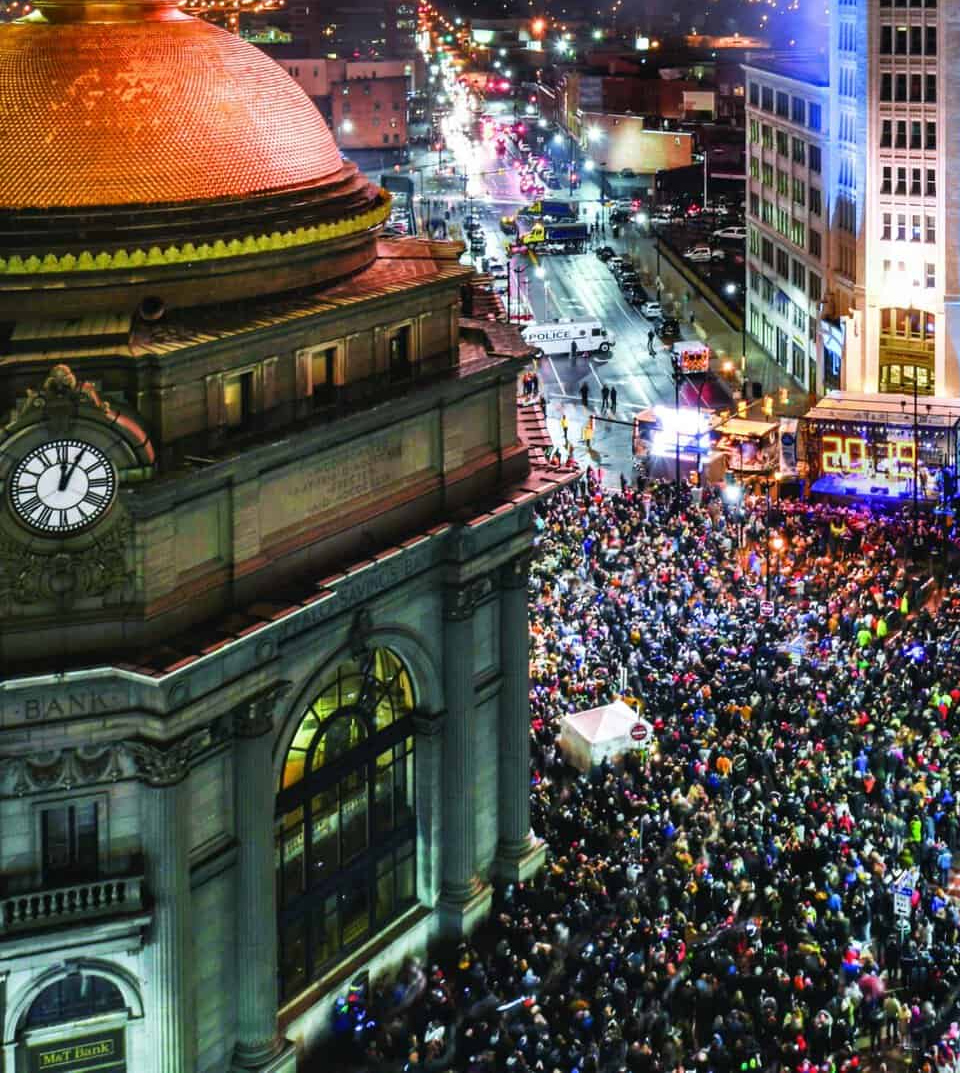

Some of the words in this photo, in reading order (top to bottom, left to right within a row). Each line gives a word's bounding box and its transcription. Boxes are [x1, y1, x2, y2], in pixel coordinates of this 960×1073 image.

[528, 330, 569, 341] POLICE
[25, 690, 108, 720] BANK
[75, 1043, 110, 1059] Bank
